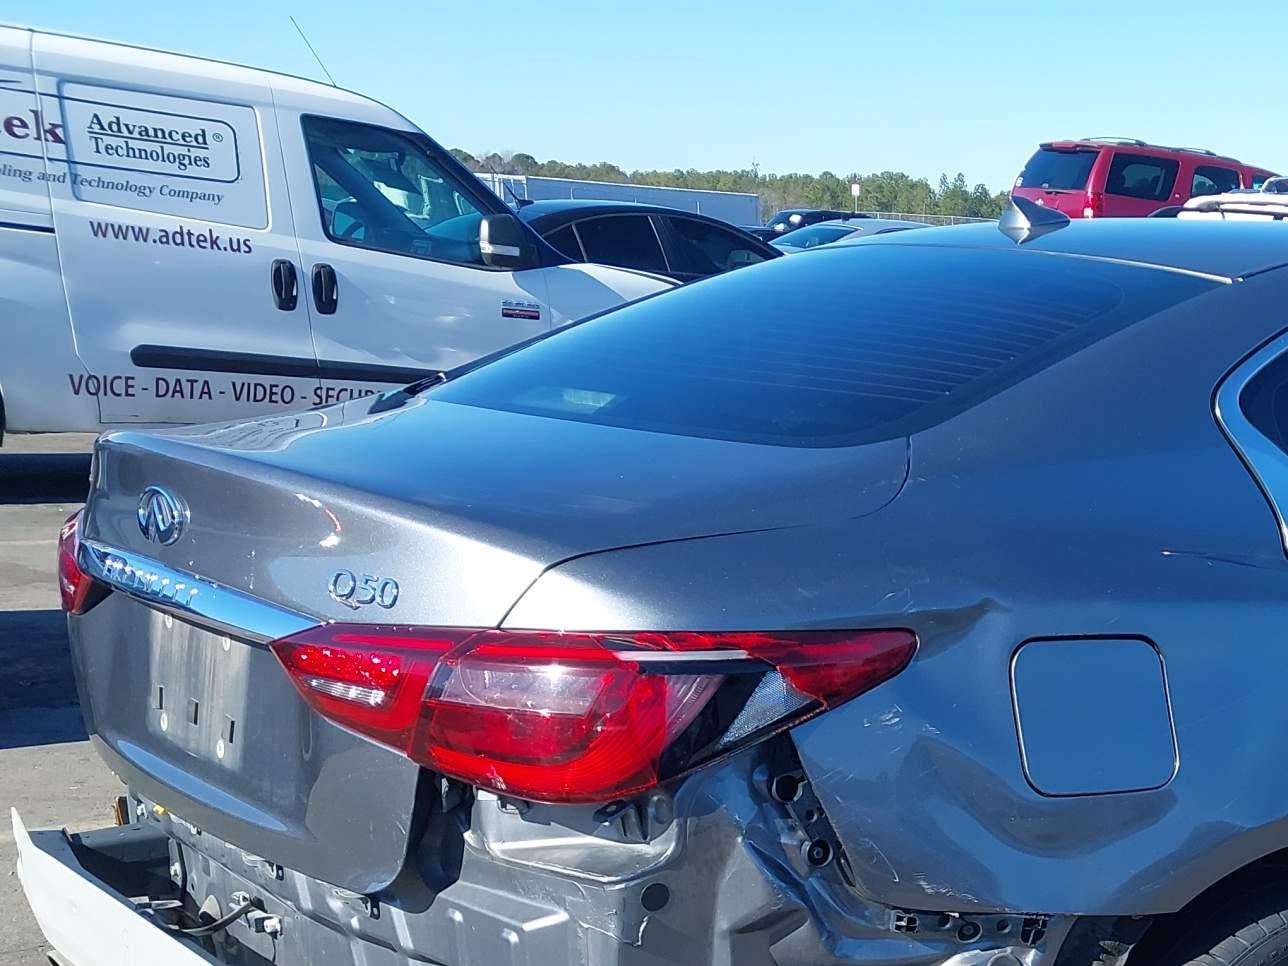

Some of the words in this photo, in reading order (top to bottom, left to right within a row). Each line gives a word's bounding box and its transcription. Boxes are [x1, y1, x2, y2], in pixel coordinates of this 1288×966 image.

[87, 113, 209, 146] Advanced
[89, 135, 211, 170] Technologies
[37, 171, 66, 184] and
[71, 172, 156, 197] Technology
[159, 184, 224, 205] Company
[89, 220, 253, 254] www.adtek.us
[69, 374, 136, 398] VOICE
[155, 376, 213, 400] DATA
[232, 381, 296, 405] VIDEO
[327, 568, 400, 611] Q50
